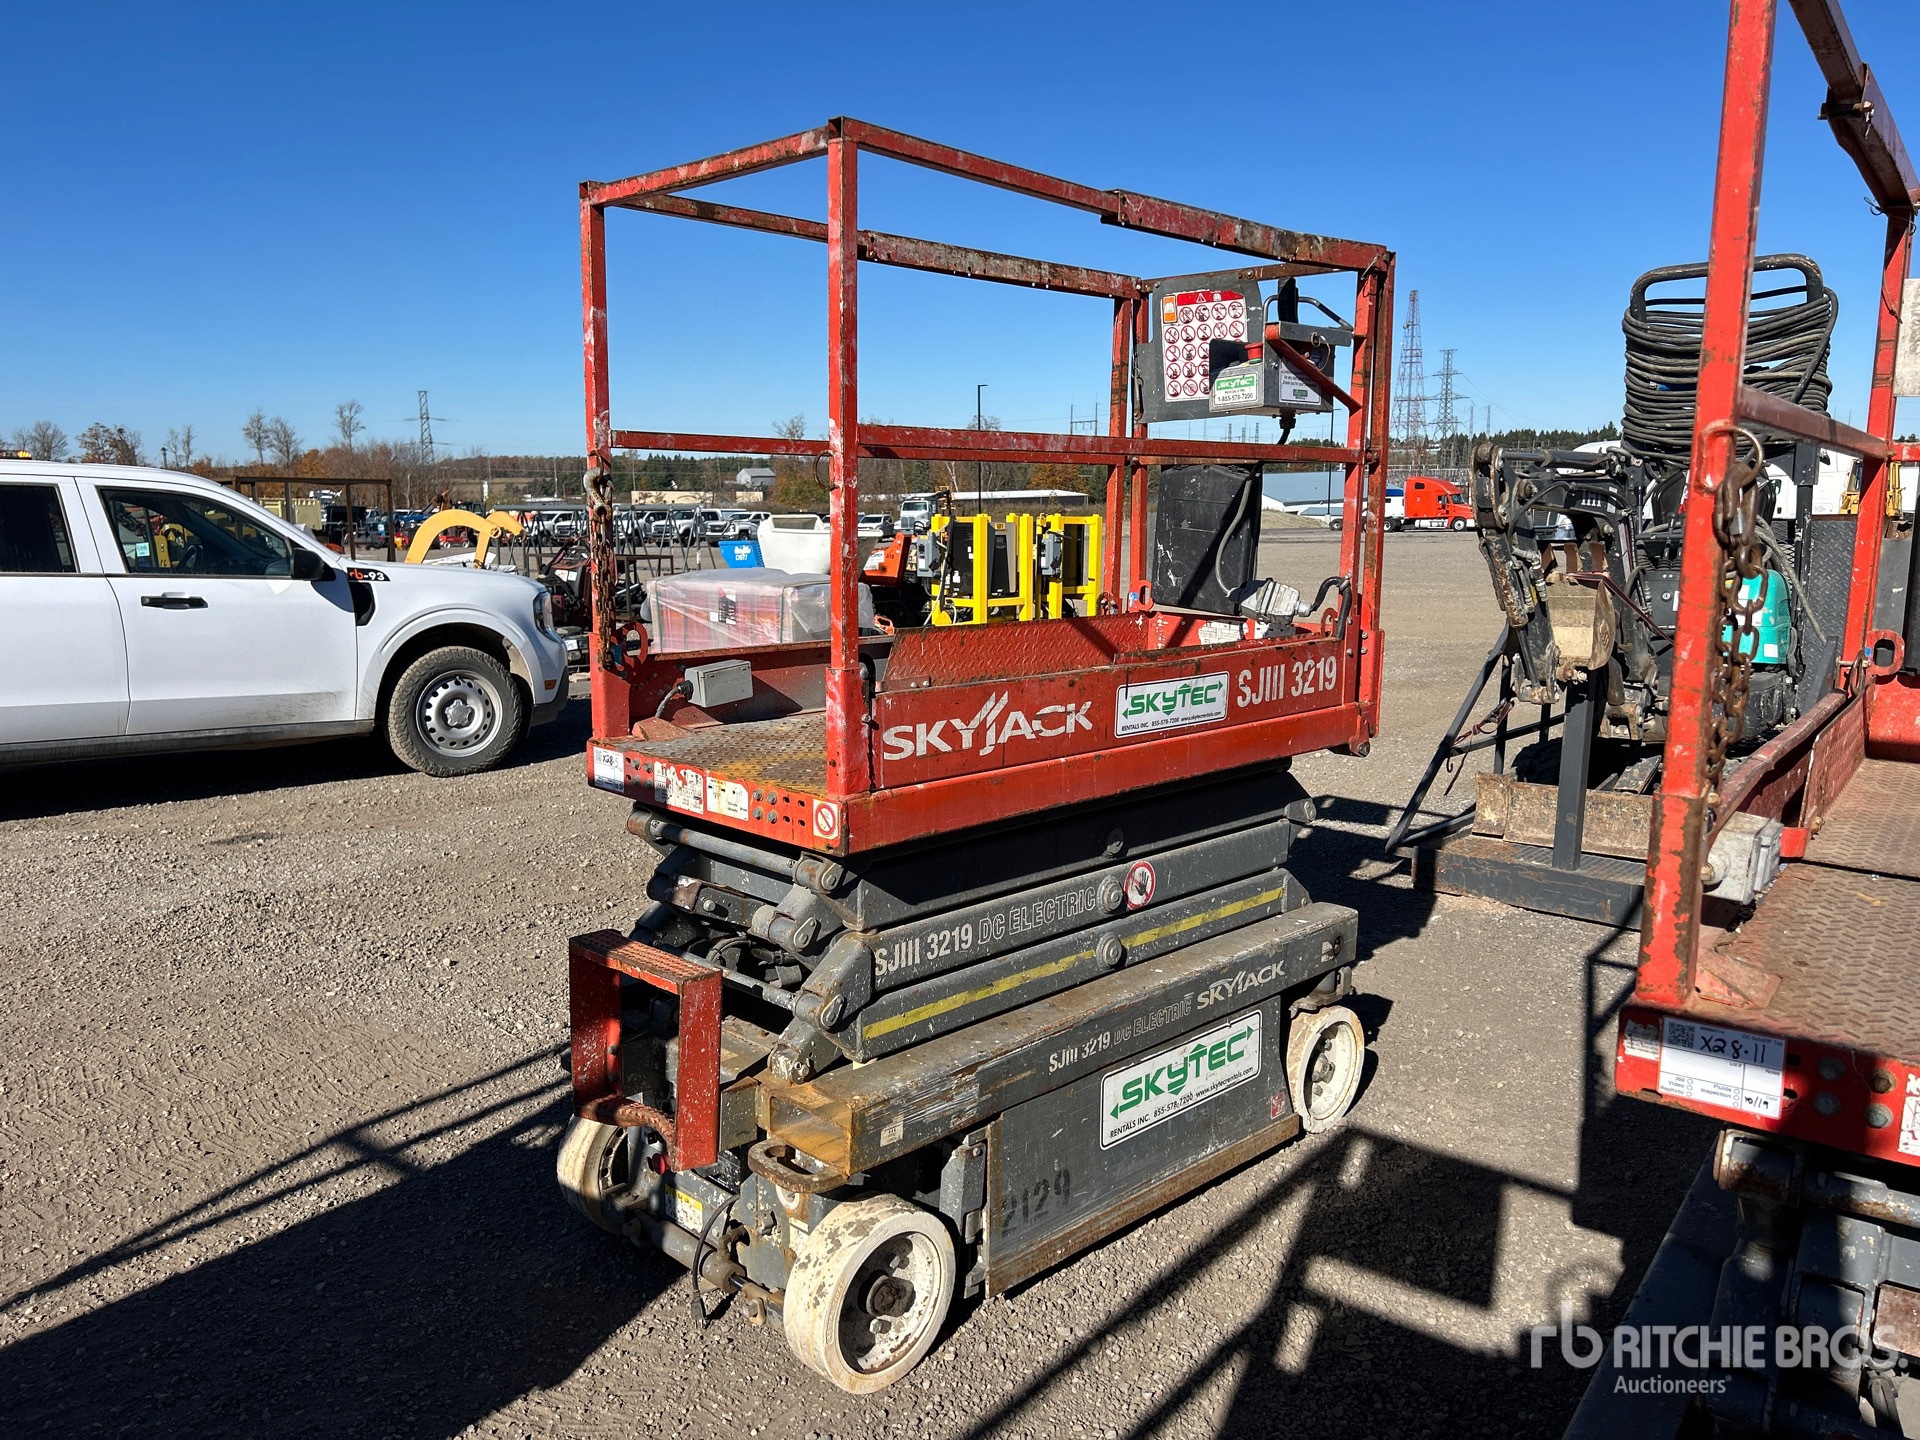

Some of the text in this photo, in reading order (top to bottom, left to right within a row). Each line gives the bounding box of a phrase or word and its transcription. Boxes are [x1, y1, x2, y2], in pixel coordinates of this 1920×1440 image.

[1290, 655, 1337, 697] 3219
[1127, 683, 1220, 716] SKYTEC
[882, 690, 1093, 761] SKYJACK
[1121, 722, 1140, 731] RENTALS
[1151, 717, 1180, 727] 855-578-7200
[926, 923, 973, 960] 3219
[978, 913, 1006, 945] DC
[1008, 886, 1096, 936] ELECTRIC
[1081, 1031, 1111, 1059] 3219
[1113, 1025, 1132, 1046] DC
[1133, 997, 1192, 1037] ELECTRIC
[1196, 960, 1286, 1010] SKYJACK
[1118, 1031, 1248, 1114] SKYTEC
[1668, 1080, 1685, 1088] Video
[1700, 1088, 1732, 1099] Inspection
[1713, 1084, 1732, 1092] Fluids
[1109, 1066, 1254, 1139] RENTALS INC. 855-578-7200 www.skytecrentals.com
